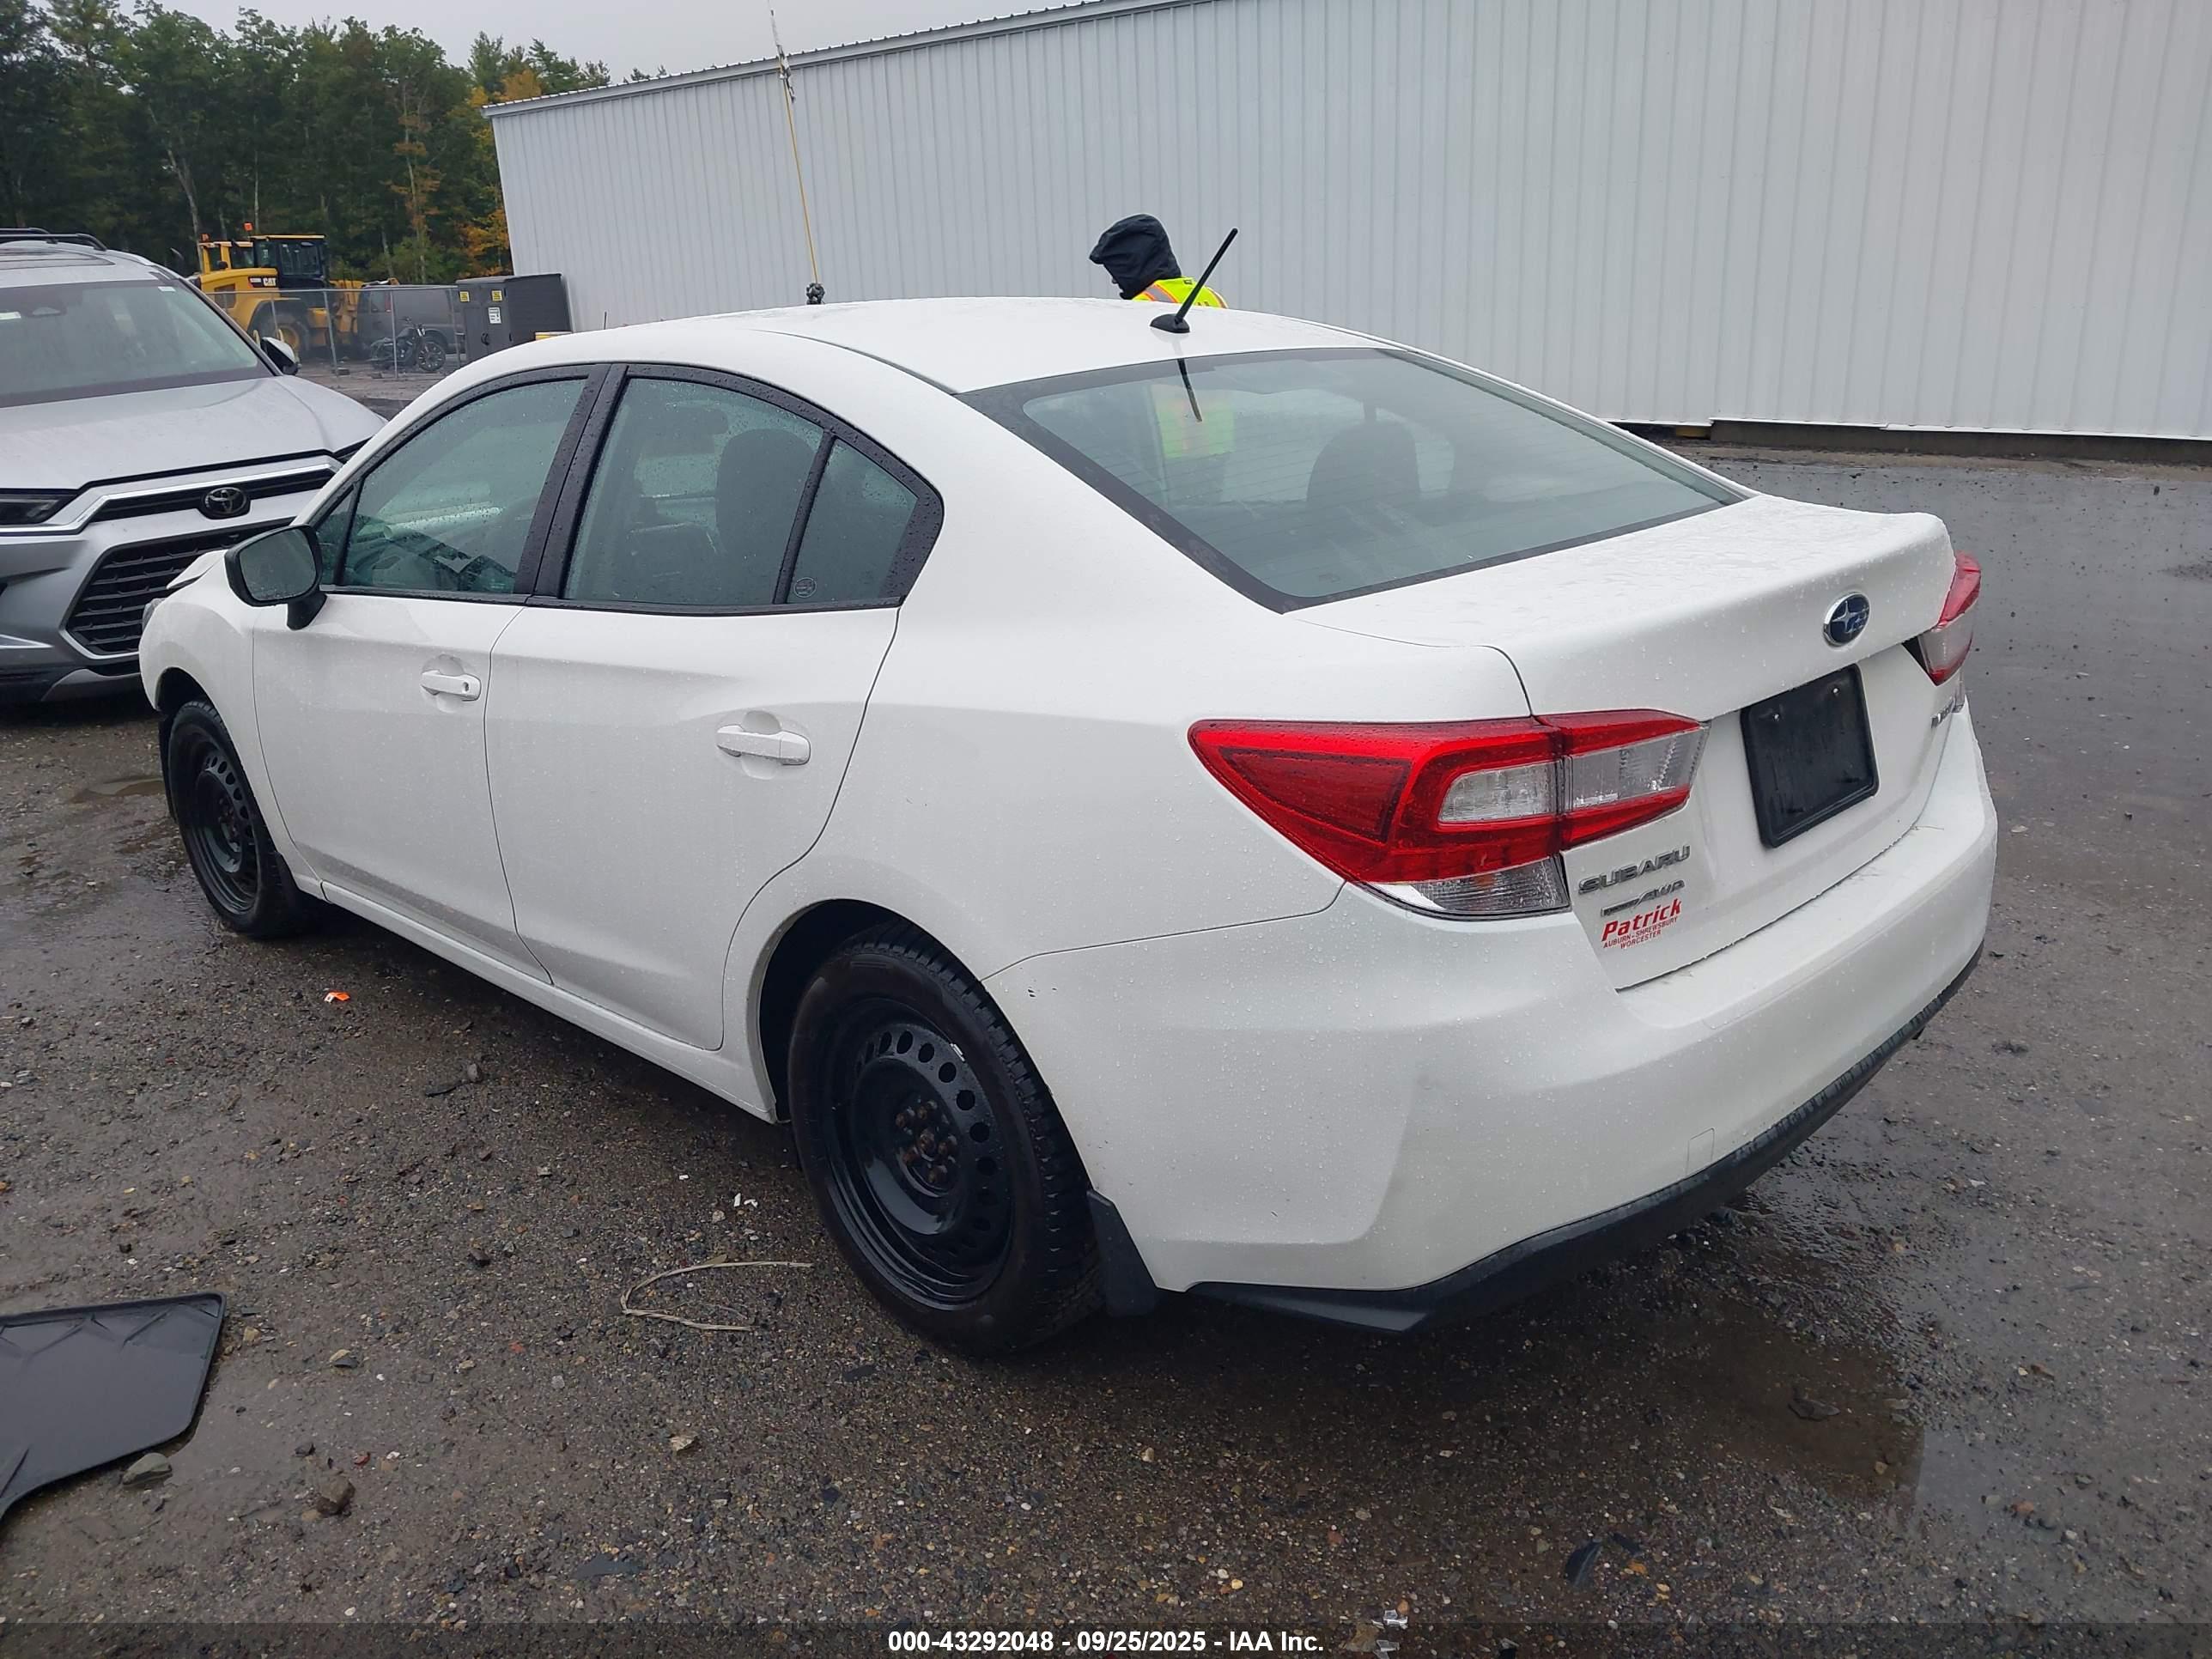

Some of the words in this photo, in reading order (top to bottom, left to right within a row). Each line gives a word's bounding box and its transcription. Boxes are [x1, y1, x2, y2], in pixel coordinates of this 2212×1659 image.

[263, 277, 276, 287] CAT
[1577, 844, 1691, 896] SUBARU
[1601, 897, 1682, 942] Patrick
[1620, 929, 1662, 950] WORCESTER
